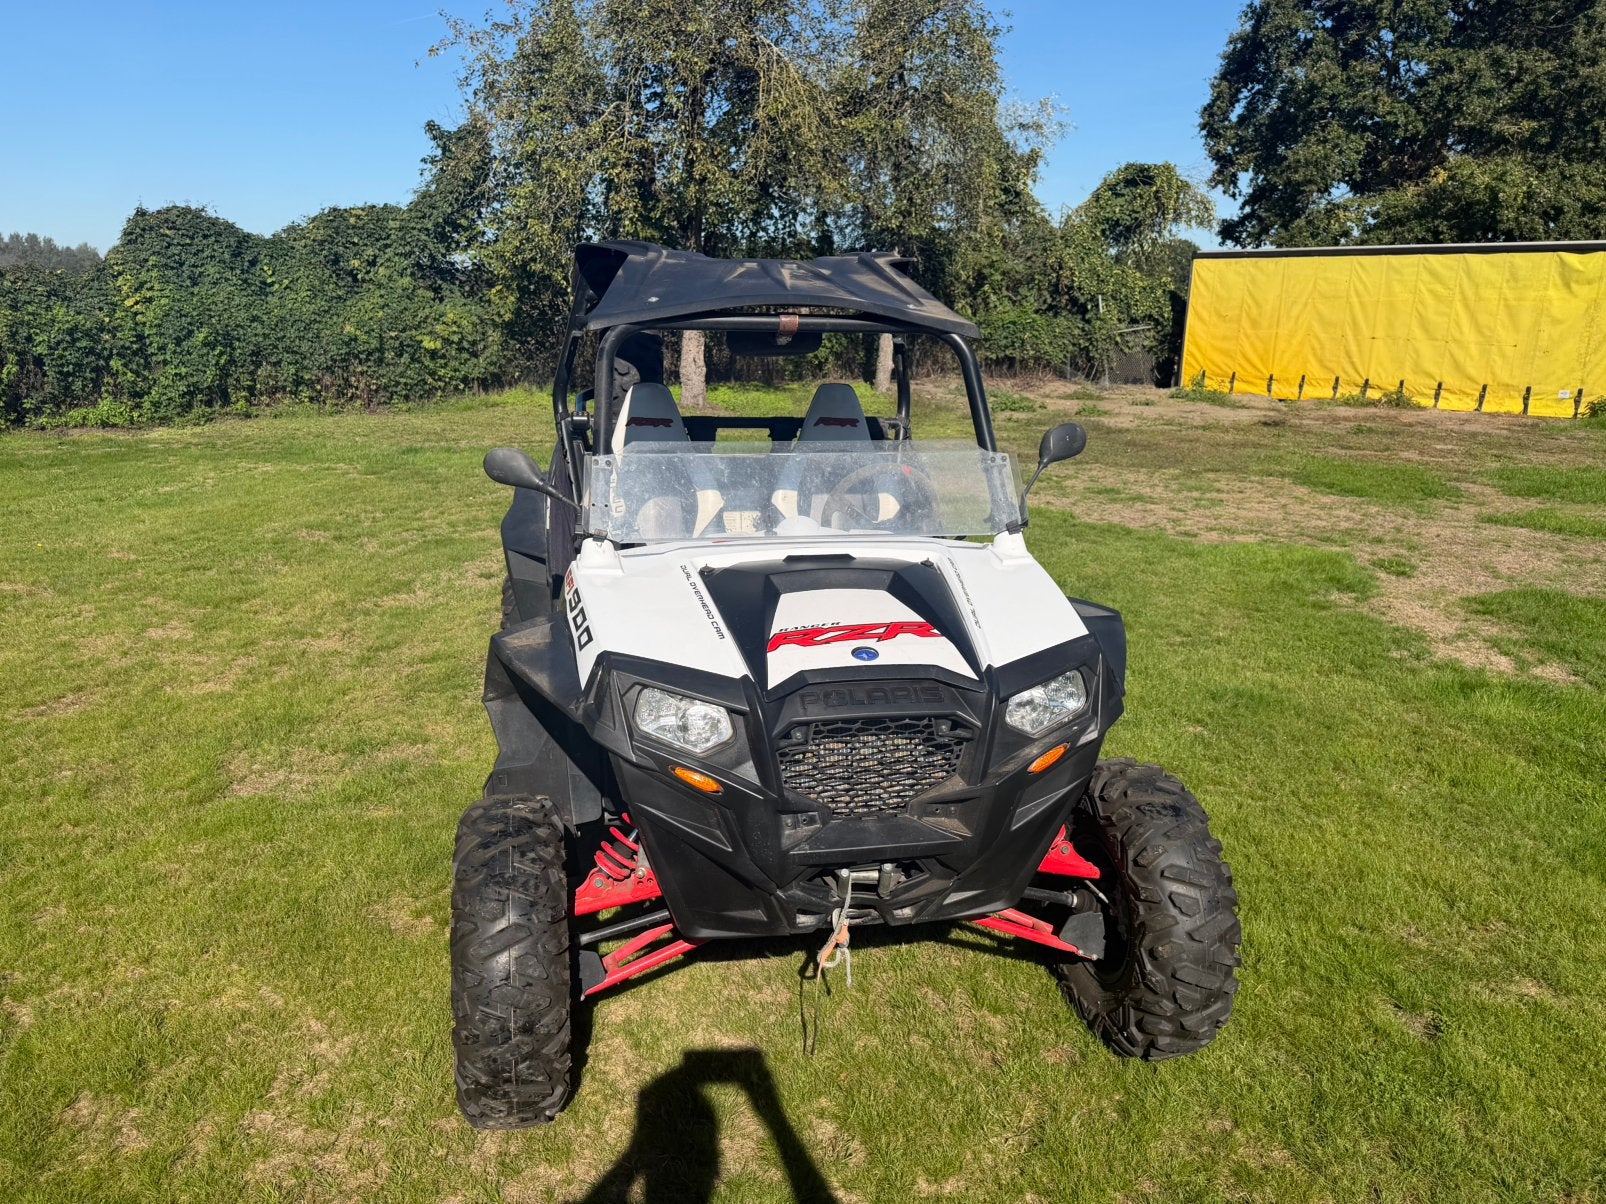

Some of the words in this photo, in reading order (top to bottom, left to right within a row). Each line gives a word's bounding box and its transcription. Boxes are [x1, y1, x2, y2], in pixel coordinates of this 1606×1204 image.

[568, 587, 594, 652] 900
[680, 564, 693, 582] DUAL
[689, 581, 715, 620] OVERHEAD
[711, 620, 726, 640] CAM
[766, 621, 944, 653] RZR
[799, 685, 945, 711] POLARIS
